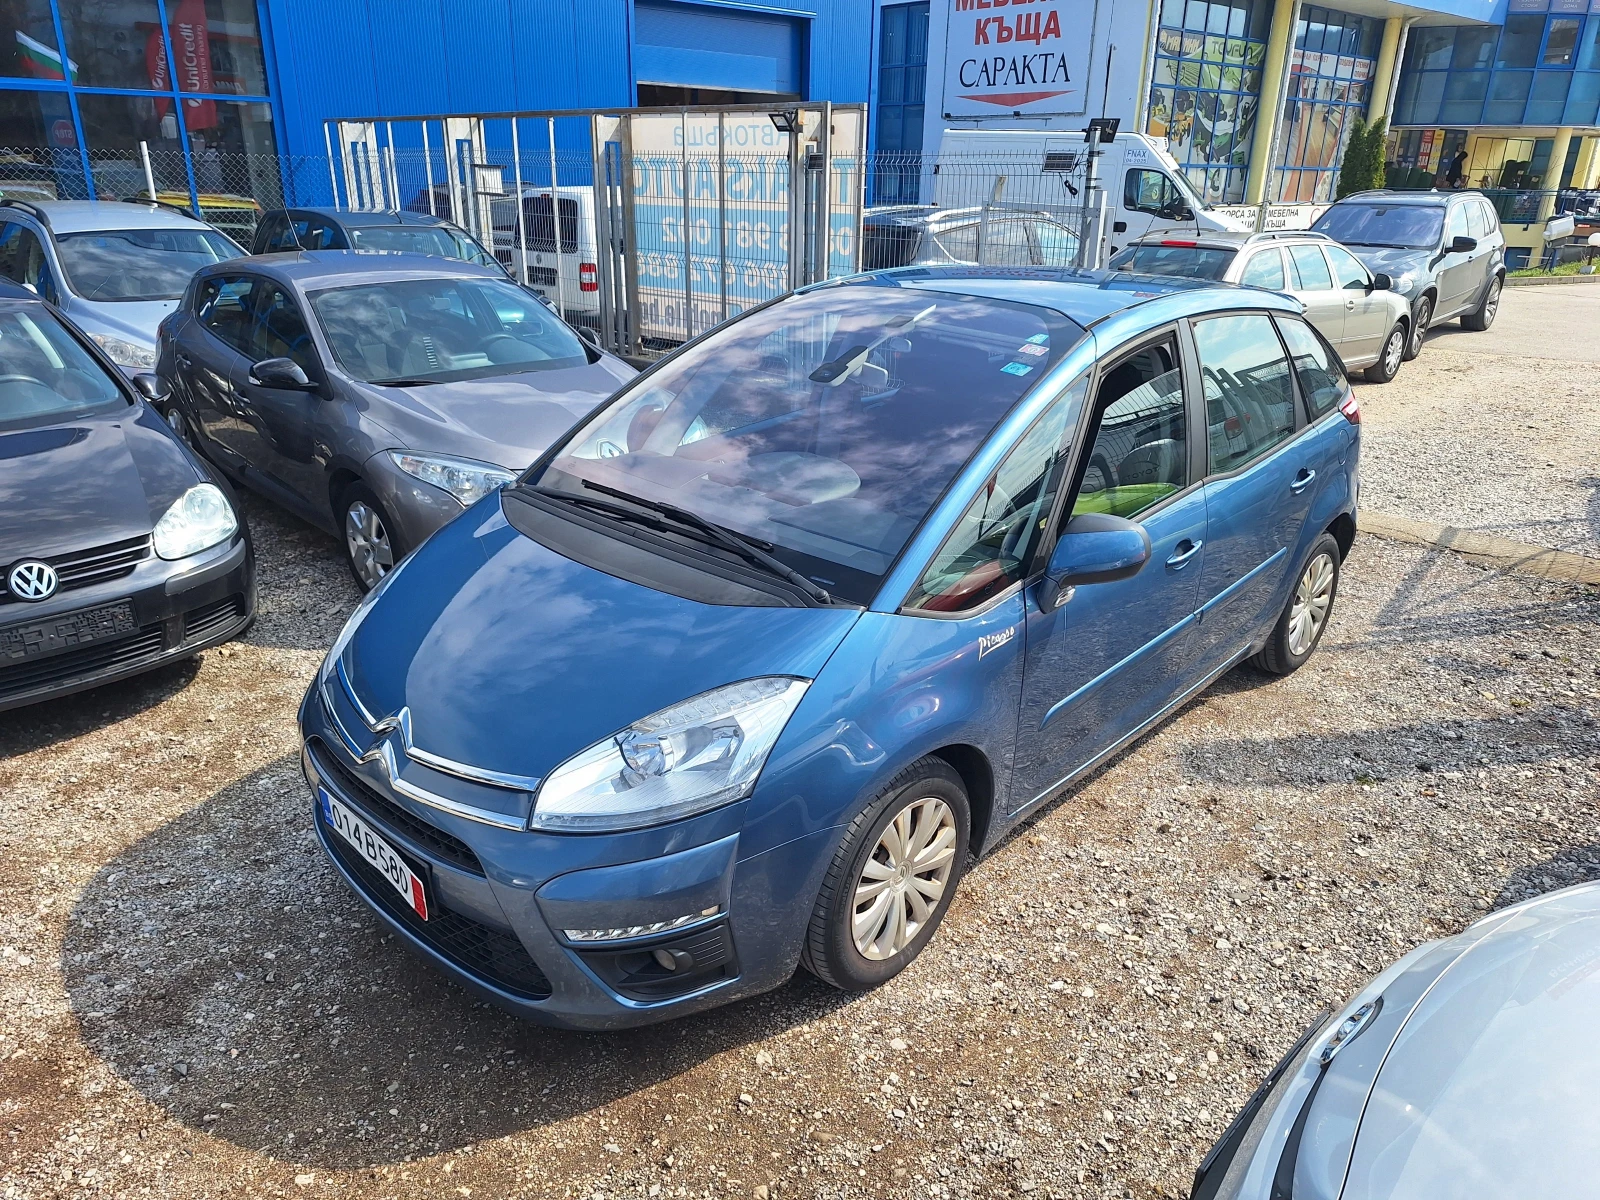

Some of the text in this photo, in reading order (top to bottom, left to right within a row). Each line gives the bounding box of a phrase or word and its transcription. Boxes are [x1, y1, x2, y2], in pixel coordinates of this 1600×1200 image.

[975, 10, 1061, 45] КЪЩА
[959, 52, 1071, 87] САРАКТА
[1265, 219, 1286, 229] КЪЩА
[1268, 208, 1299, 218] МЕБЕЛНА
[978, 625, 1015, 662] Picasso
[331, 803, 409, 895] 014B580
